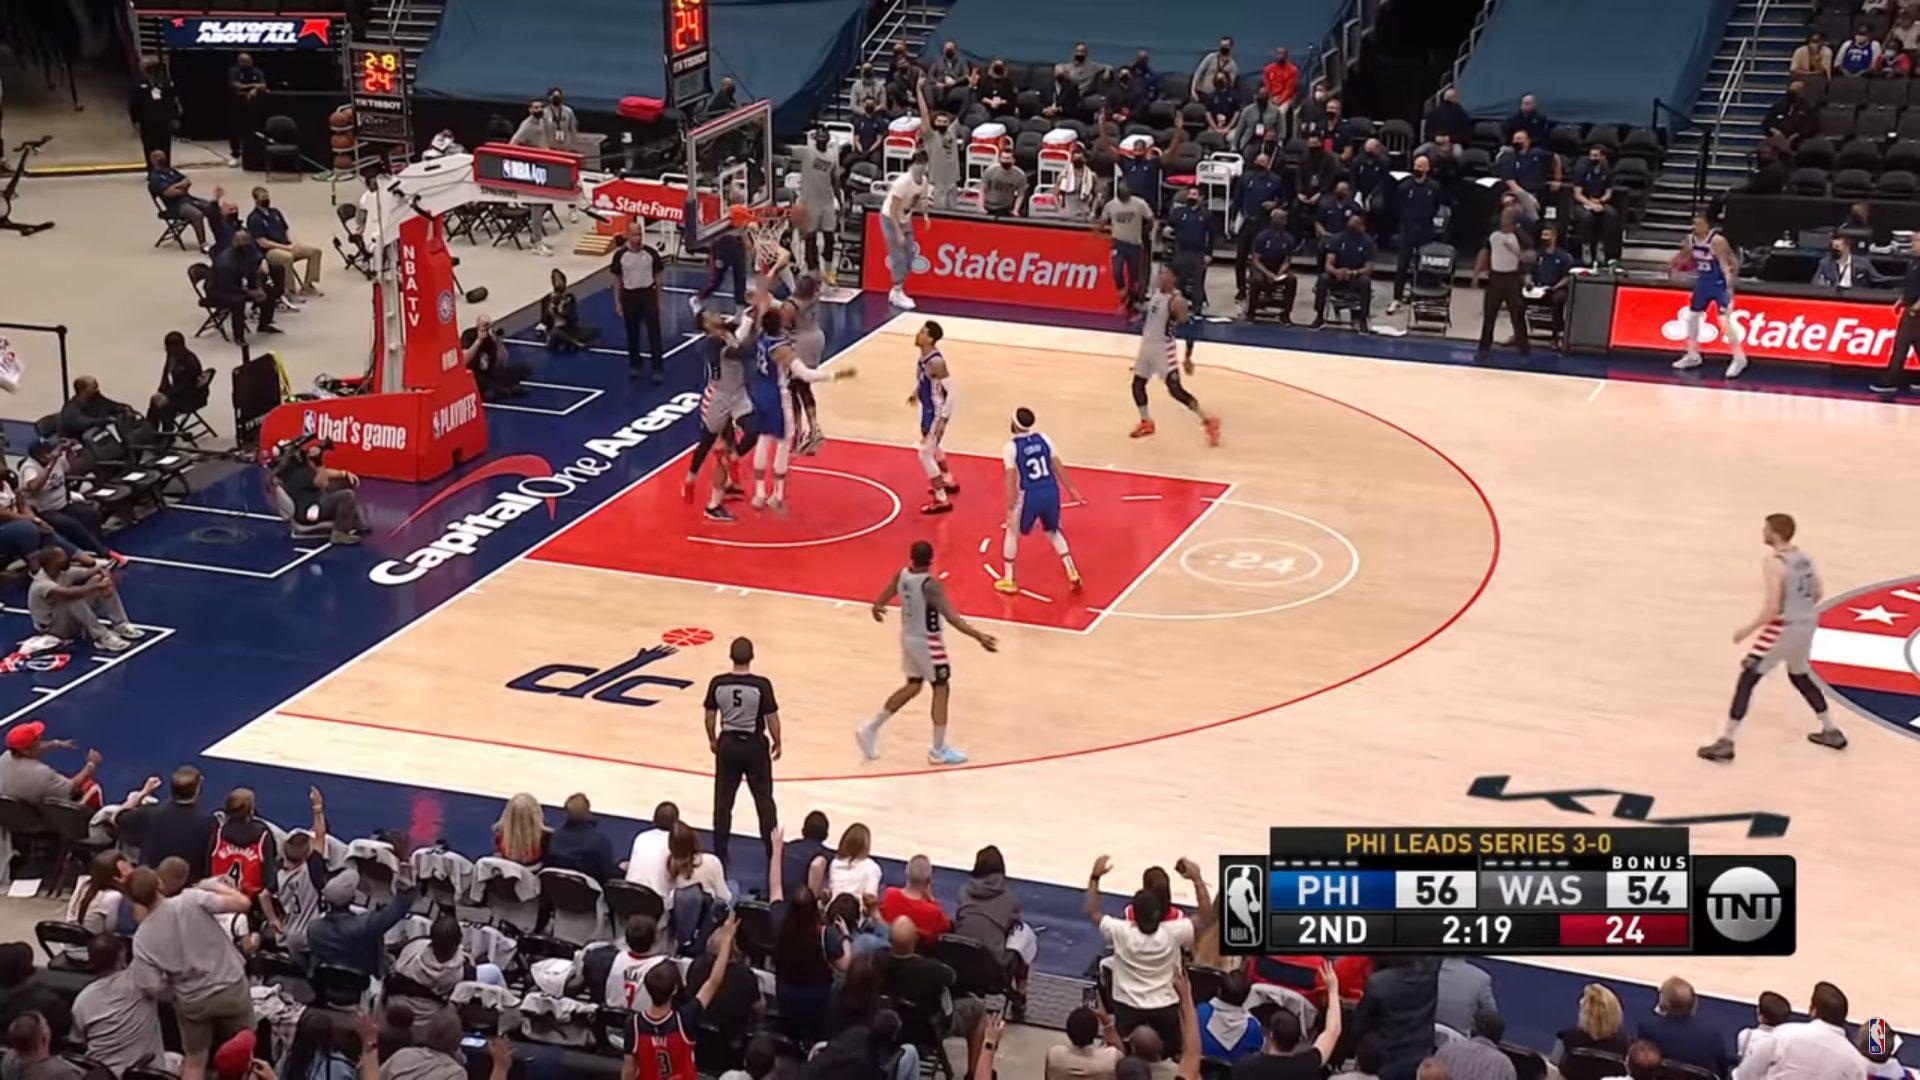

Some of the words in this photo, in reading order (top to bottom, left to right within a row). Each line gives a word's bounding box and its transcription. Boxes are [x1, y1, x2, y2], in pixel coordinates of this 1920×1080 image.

[196, 32, 260, 43] ABOVE
[262, 32, 298, 43] ALL
[199, 22, 295, 32] PLAYOFFS
[675, 9, 699, 50] 24
[365, 70, 392, 91] 24
[511, 160, 533, 181] NBA
[403, 245, 418, 291] NBA
[934, 243, 1016, 282] State
[1018, 252, 1098, 290] Farm
[407, 297, 419, 327] TV
[440, 392, 477, 434] PLAYOFFS
[318, 413, 361, 444] that's
[362, 422, 406, 452] game
[1026, 456, 1049, 479] 31
[369, 489, 543, 585] Capital
[518, 456, 612, 498] One
[585, 390, 702, 458] Arena
[733, 689, 742, 707] 5
